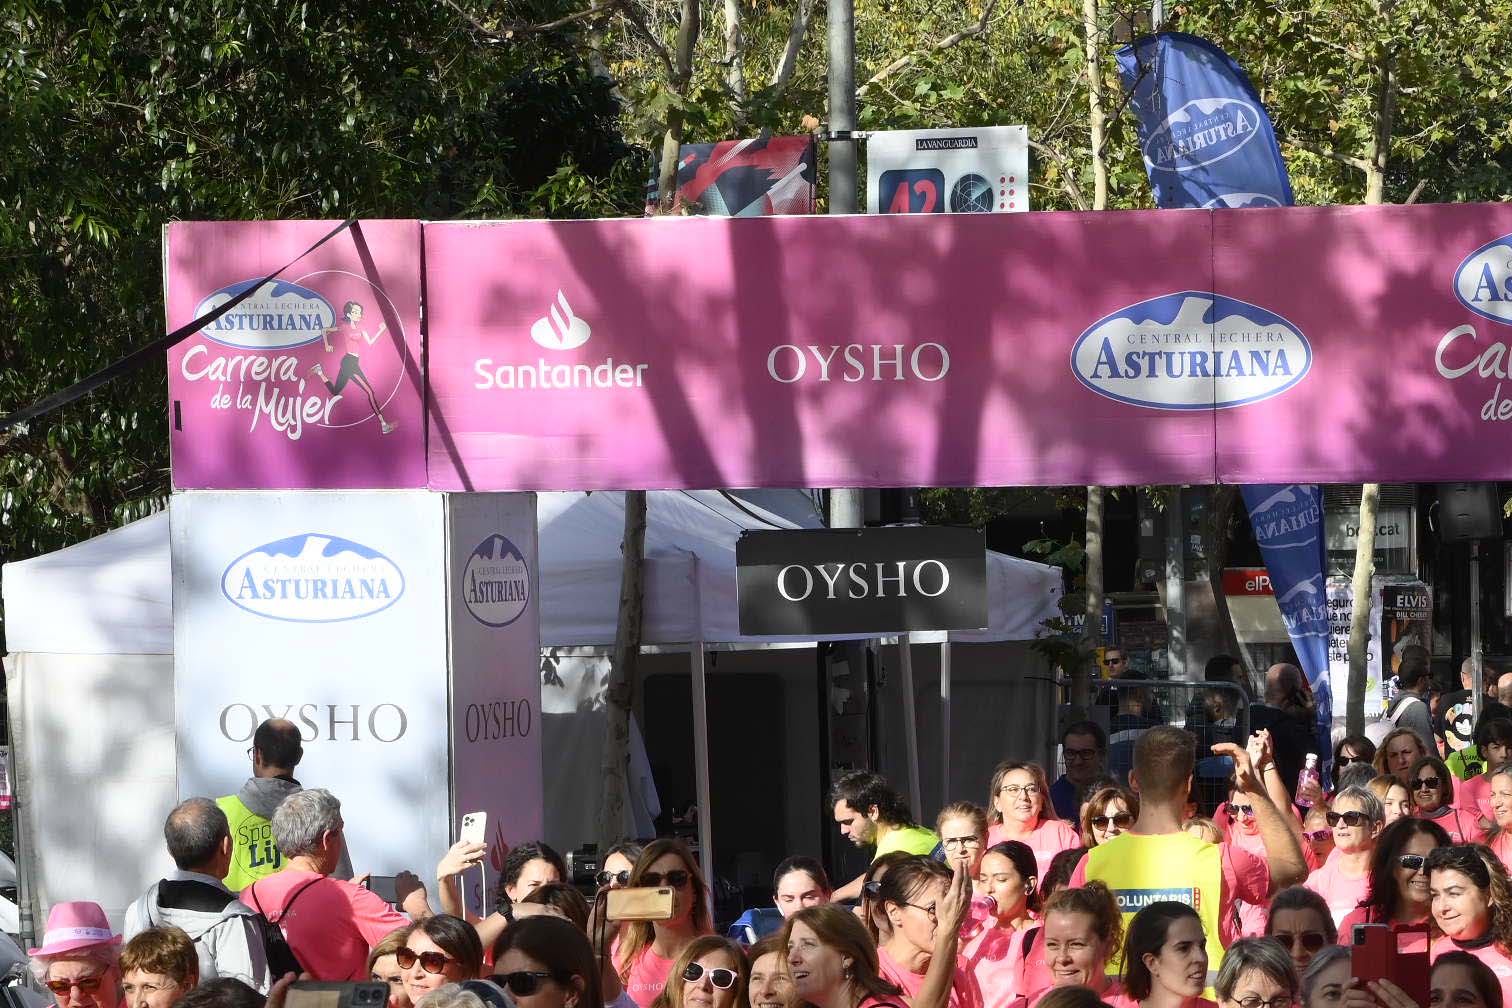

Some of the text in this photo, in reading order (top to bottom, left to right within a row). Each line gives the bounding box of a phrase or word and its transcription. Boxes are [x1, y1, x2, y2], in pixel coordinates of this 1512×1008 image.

[1126, 332, 1203, 345] CENTRAL
[181, 344, 299, 382] Carrera
[475, 356, 648, 391] Santander
[766, 342, 951, 384] OYSHO
[1089, 337, 1293, 381] ASTURIANA
[210, 376, 343, 441] de la Mujer
[236, 567, 392, 600] ASTURIANA
[467, 568, 527, 604] ASTURIANA
[776, 559, 951, 602] OYSHO
[1396, 593, 1428, 609] ELVIS
[219, 703, 409, 743] OYSHO
[465, 698, 532, 743] OYSHO
[239, 824, 272, 847] Spo
